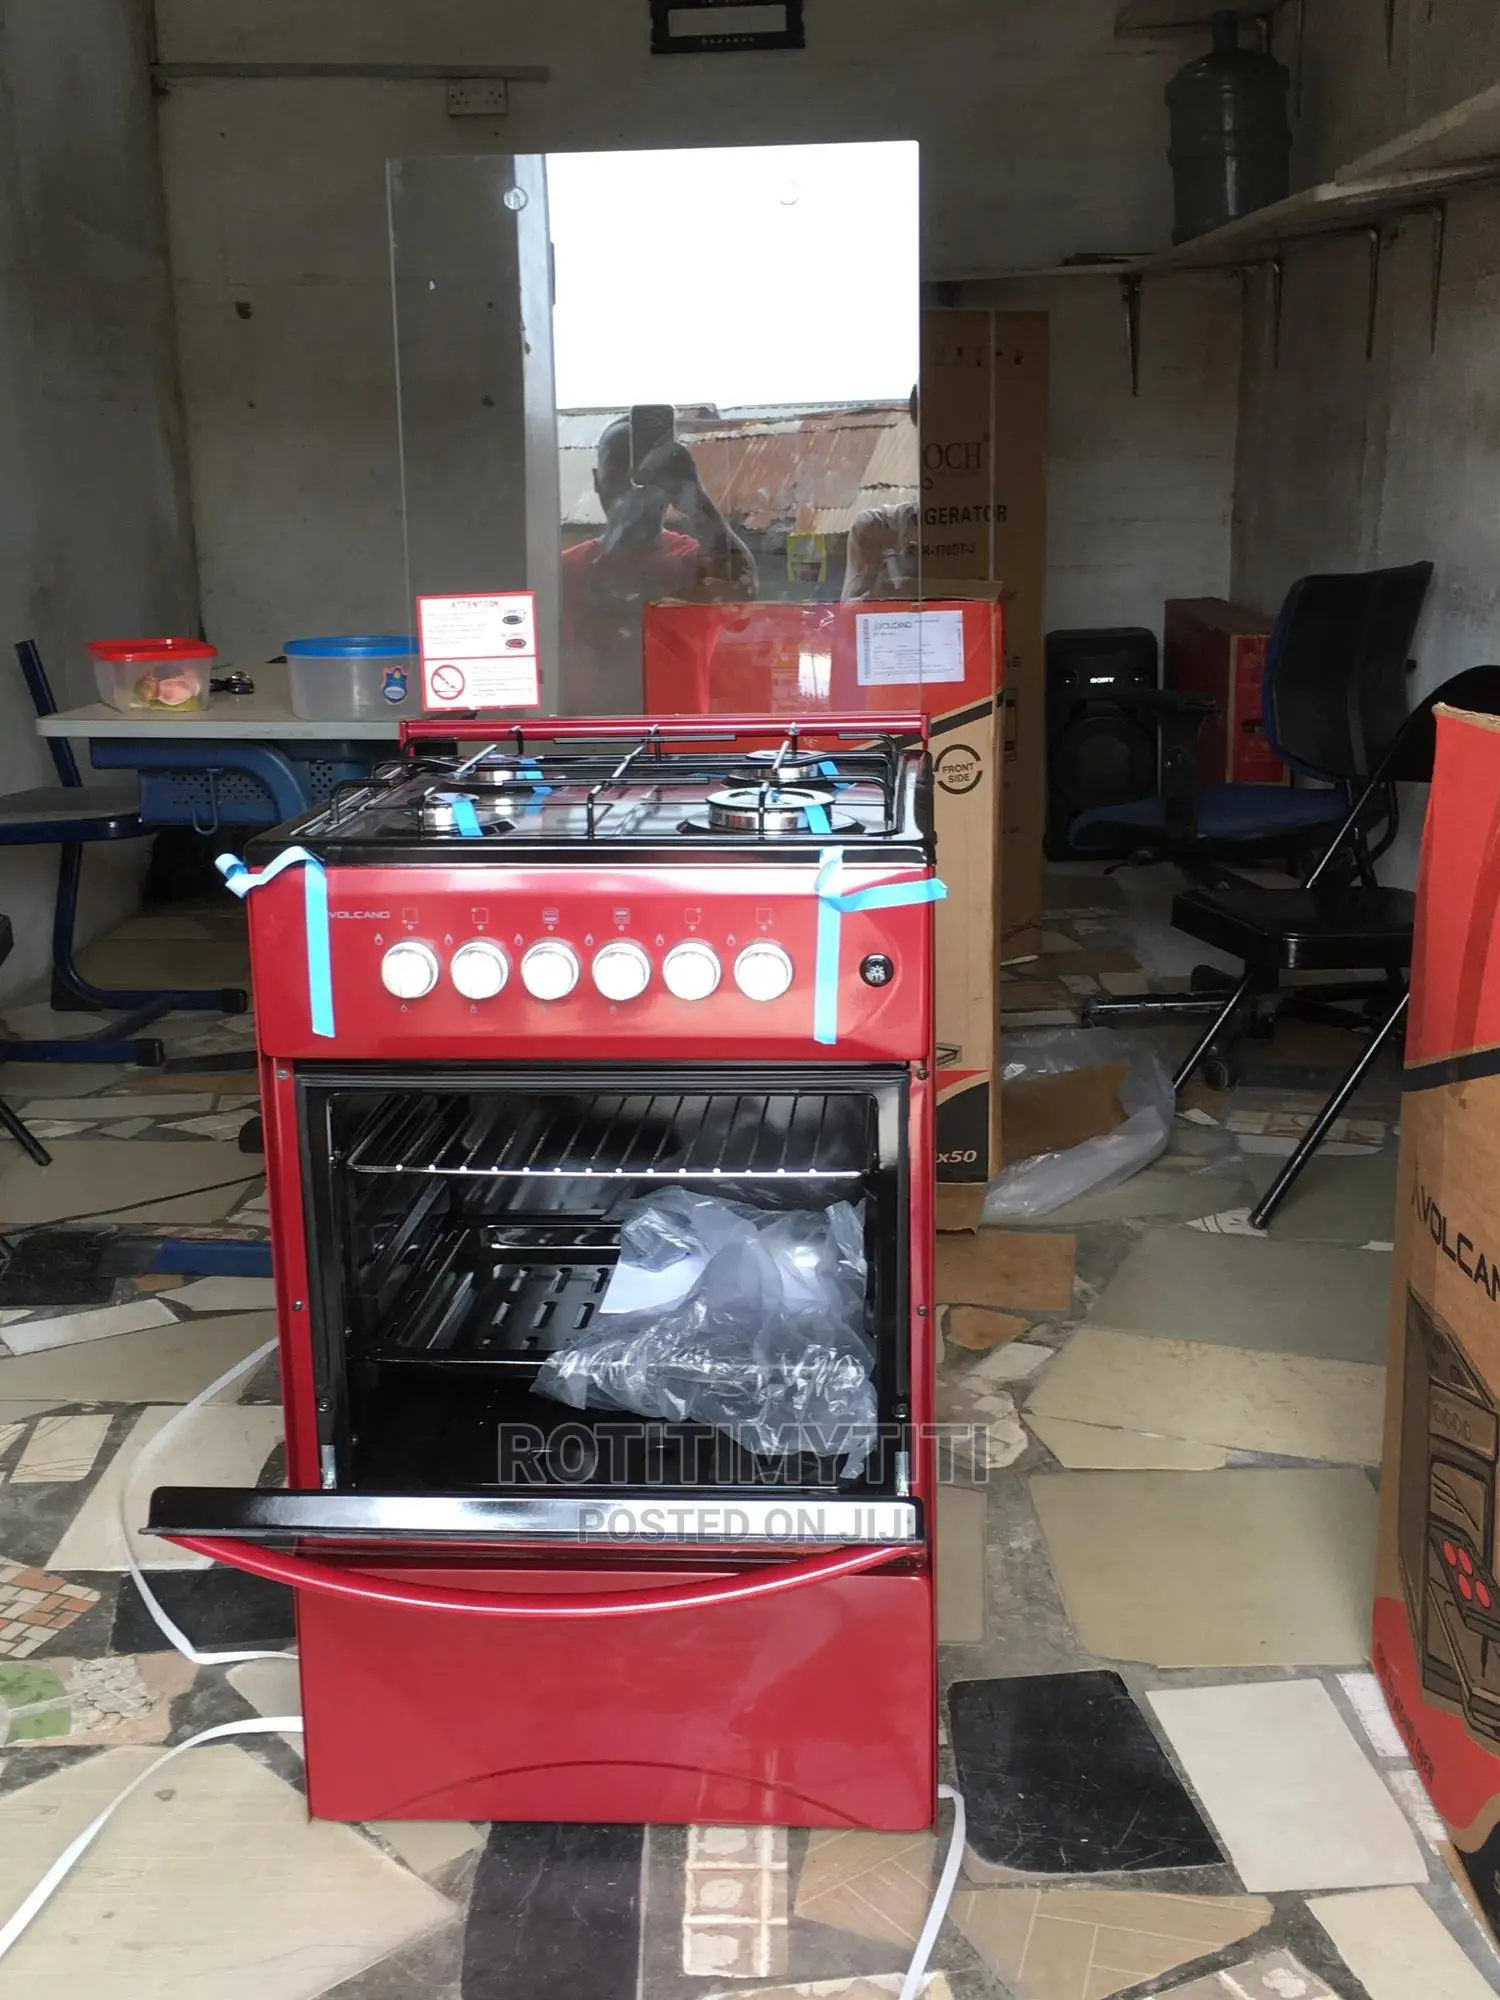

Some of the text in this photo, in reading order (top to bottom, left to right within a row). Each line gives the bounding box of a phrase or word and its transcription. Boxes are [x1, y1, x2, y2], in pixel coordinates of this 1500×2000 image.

[920, 504, 1008, 526] GERATOR
[942, 762, 974, 774] FRONT
[948, 773, 971, 783] SIDE
[328, 911, 390, 919] VOLCANO
